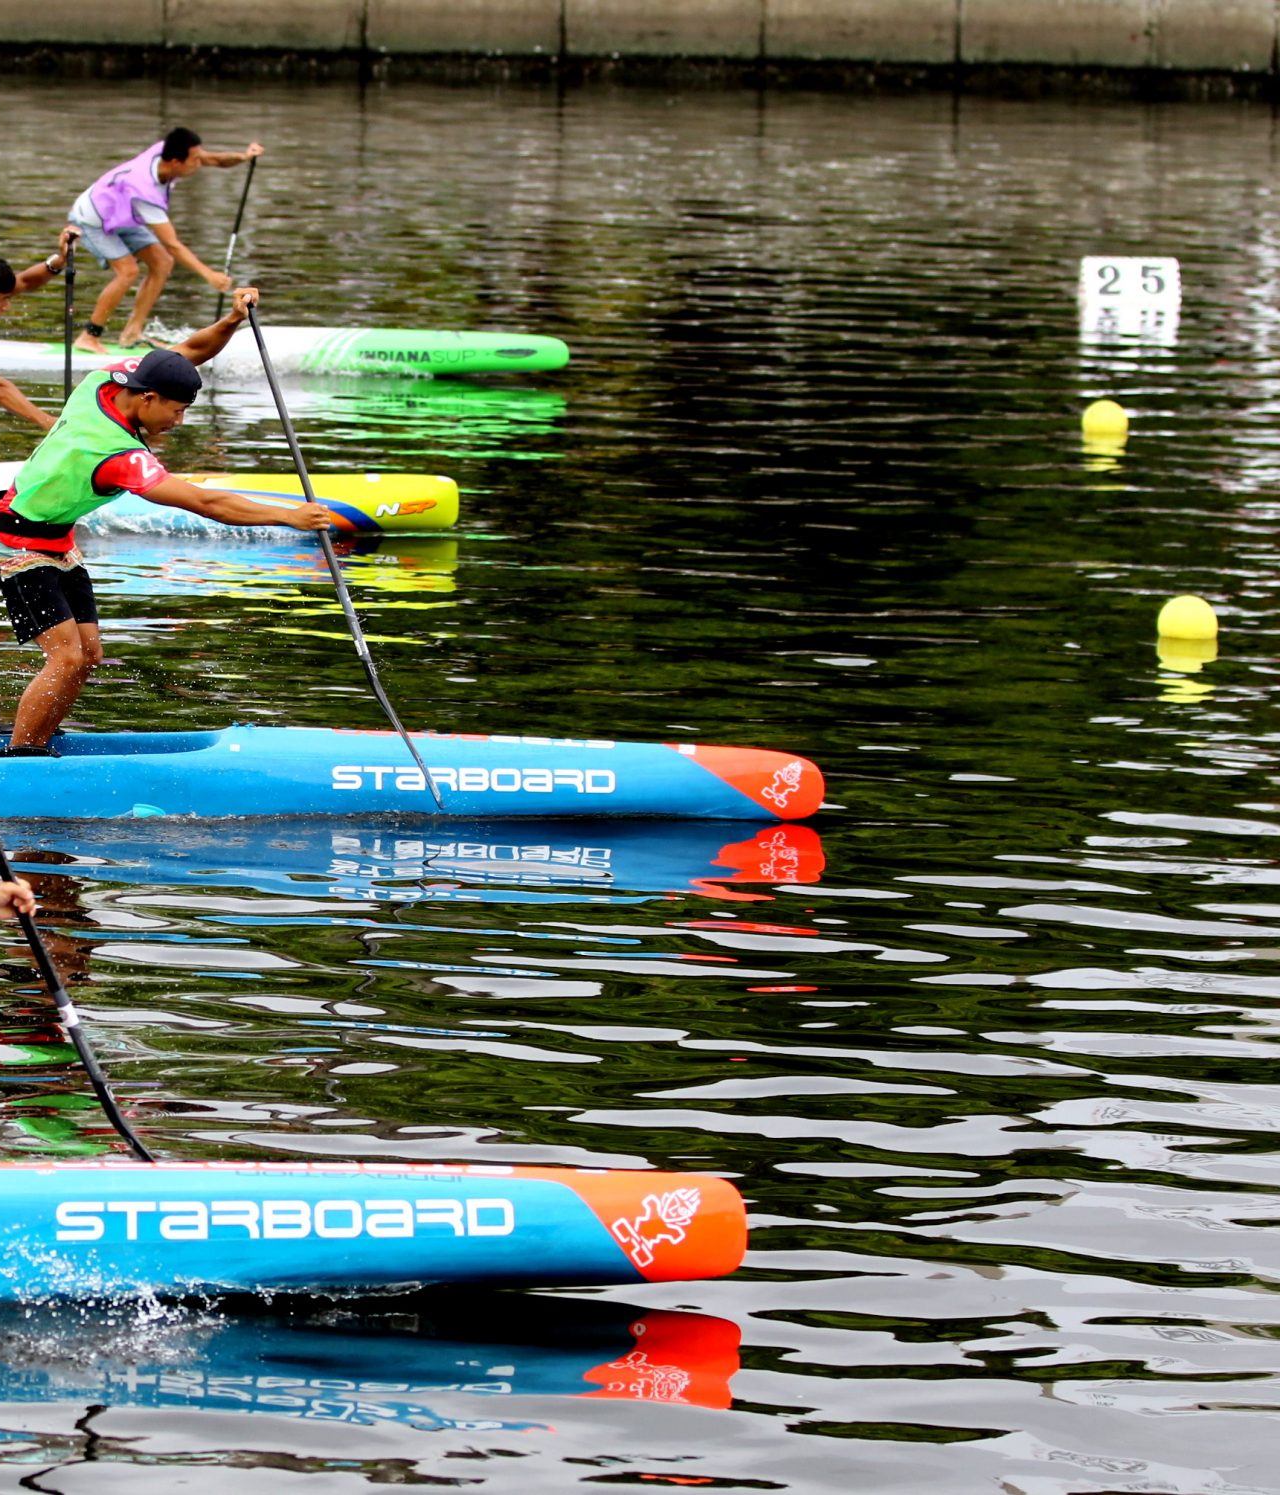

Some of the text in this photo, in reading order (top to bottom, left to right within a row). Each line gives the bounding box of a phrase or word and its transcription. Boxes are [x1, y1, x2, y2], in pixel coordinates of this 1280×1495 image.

[376, 499, 437, 517] NSP
[331, 765, 616, 794] STARBOARD
[55, 1197, 515, 1241] STARBOARD
